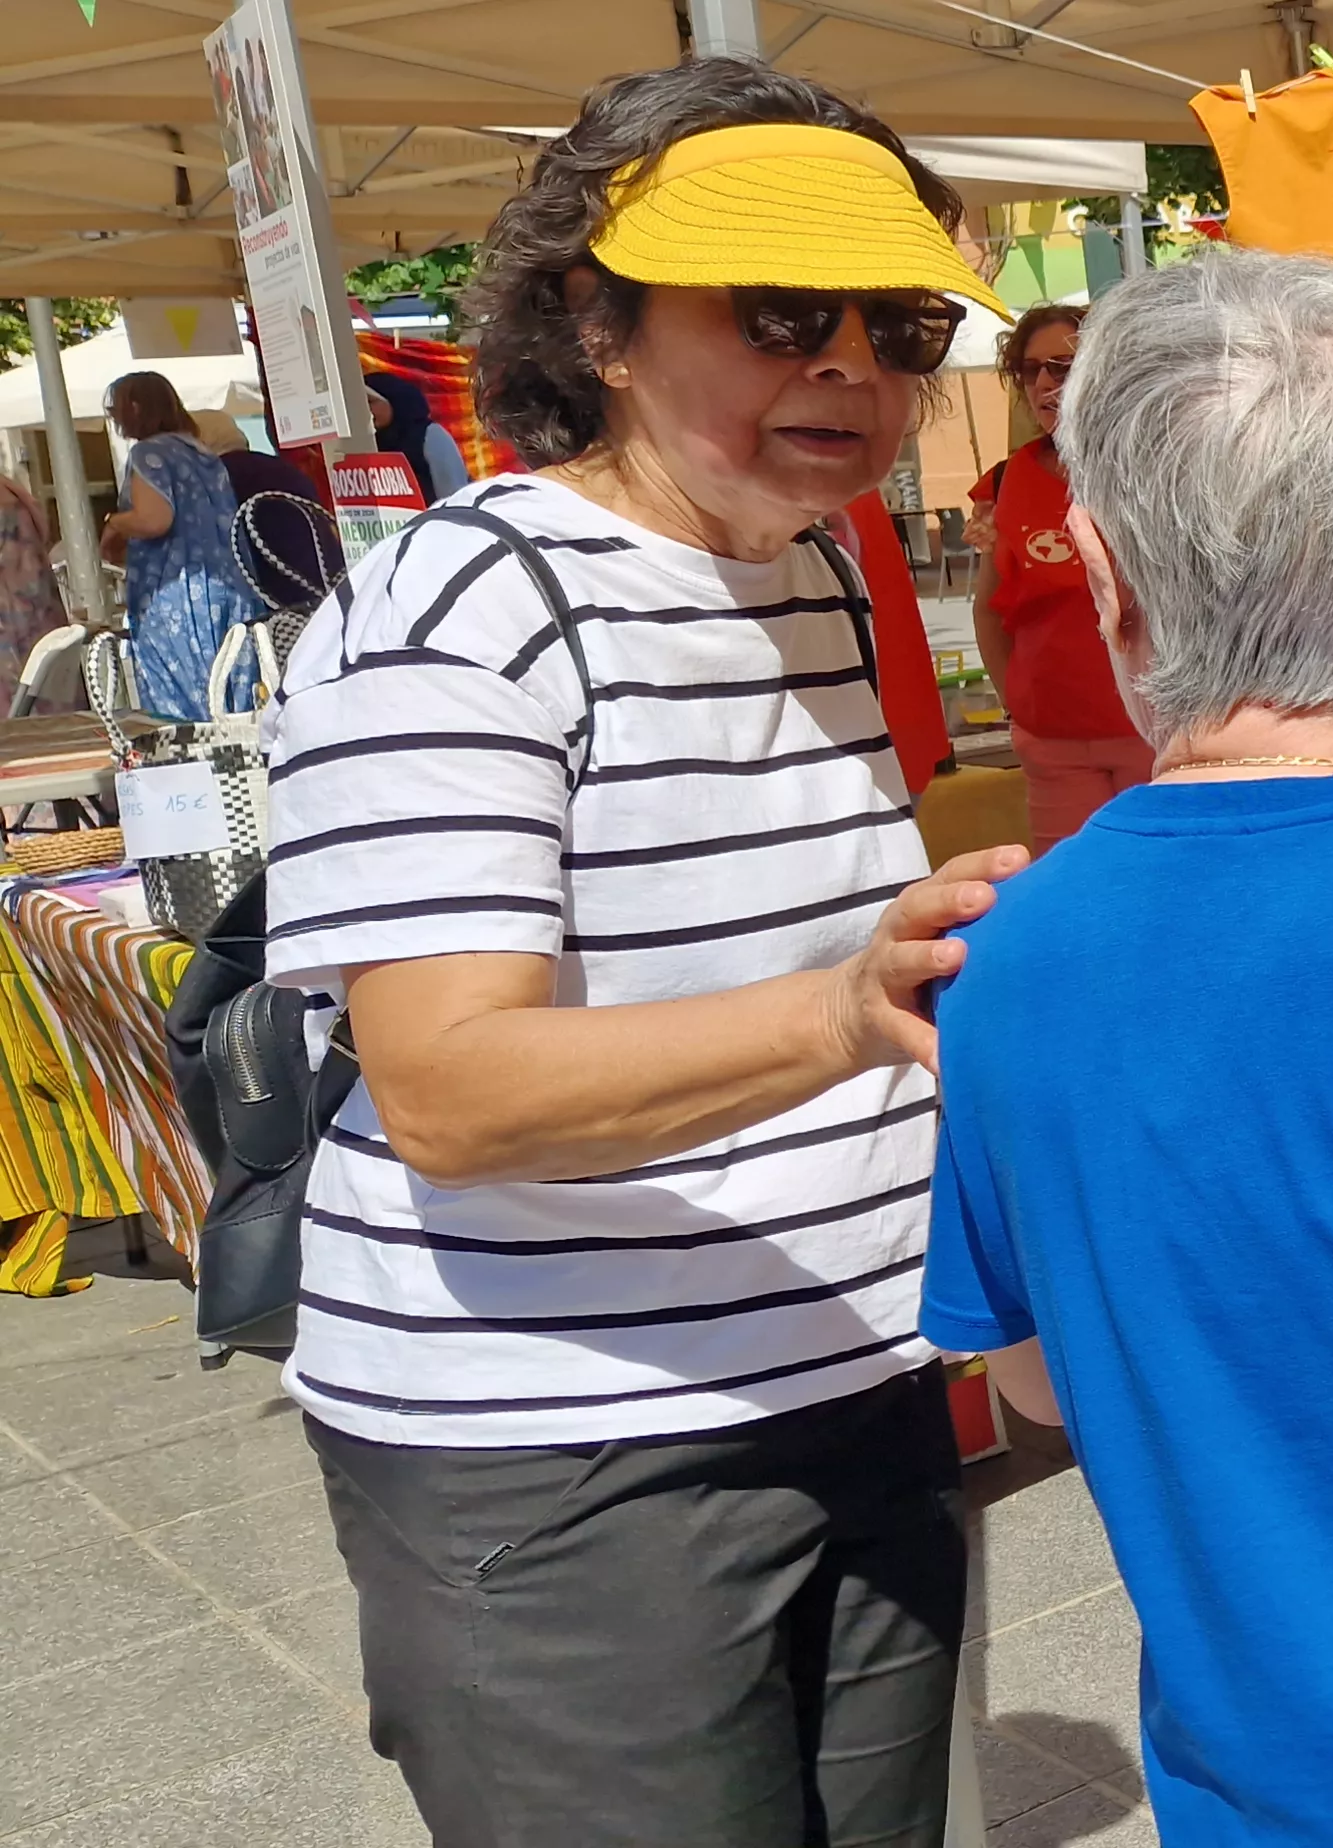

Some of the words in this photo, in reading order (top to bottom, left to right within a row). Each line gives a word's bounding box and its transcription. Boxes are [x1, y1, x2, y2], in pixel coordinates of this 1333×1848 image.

[332, 467, 370, 498] BOSCO
[367, 465, 415, 497] GLOBAL
[165, 794, 187, 812] 15
[194, 793, 208, 810] €
